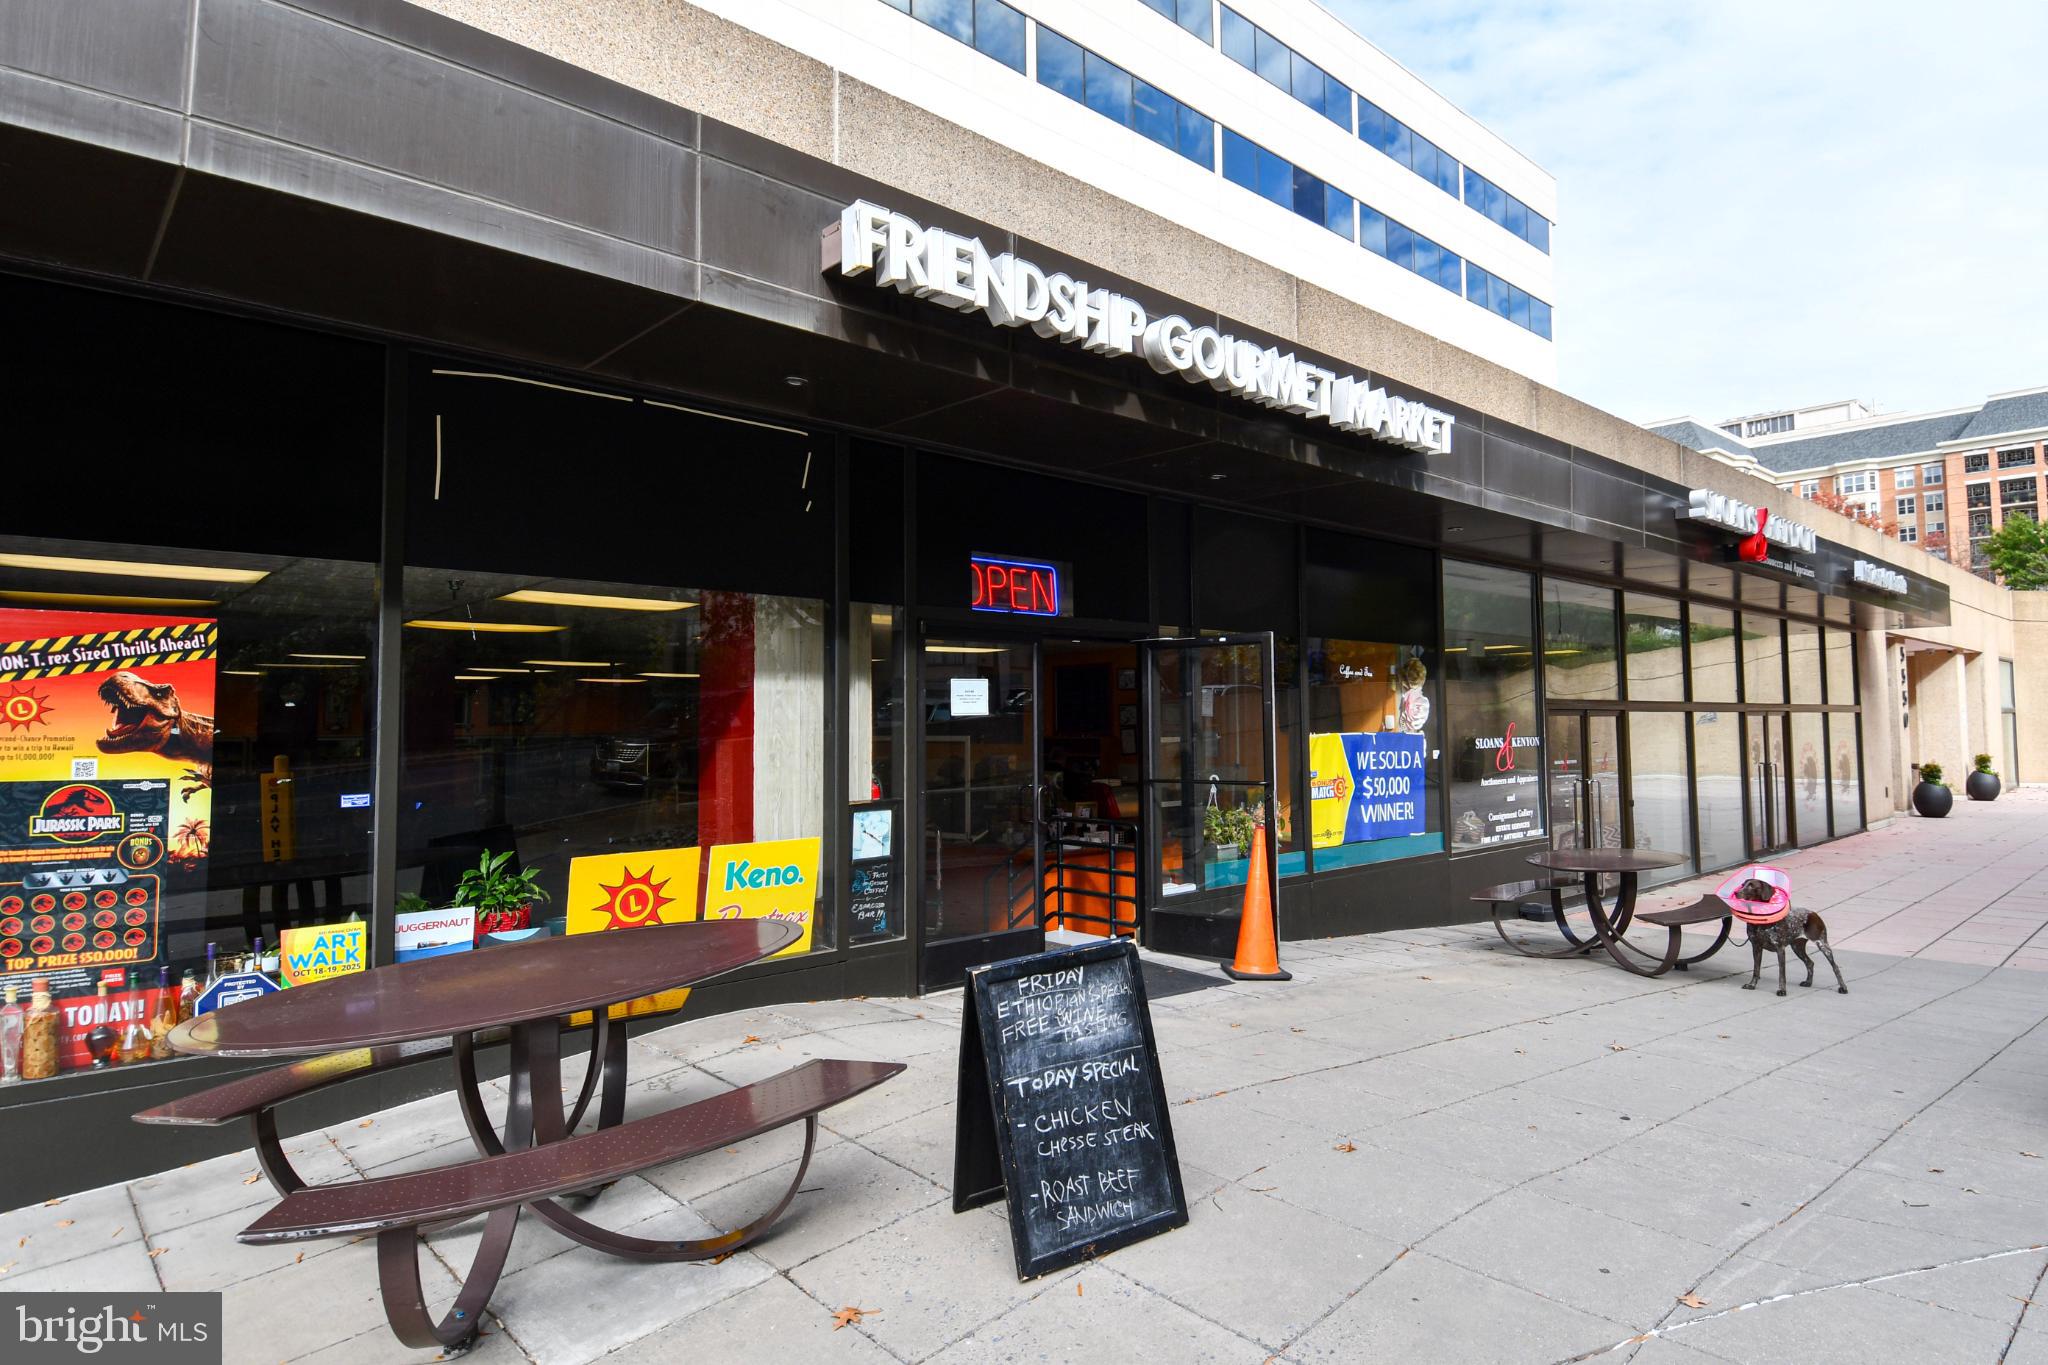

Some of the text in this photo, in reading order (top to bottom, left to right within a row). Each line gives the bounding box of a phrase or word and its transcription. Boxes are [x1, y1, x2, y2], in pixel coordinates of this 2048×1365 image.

[842, 198, 1455, 455] FRIENDSHIP GOURMET MARKET
[31, 652, 45, 668] T.
[48, 653, 71, 665] rex
[73, 646, 110, 663] Sized
[112, 640, 157, 658] Thrills
[159, 634, 206, 653] Ahead!
[1475, 737, 1504, 750] SLOANS
[1511, 736, 1540, 748] KENYON
[1357, 750, 1422, 770] WE SOLD A
[1312, 786, 1335, 799] MATCH
[1362, 775, 1410, 799] $50,000
[1361, 801, 1415, 823] WINNER!
[33, 816, 84, 833] JURASSIC
[87, 815, 121, 832] PARK
[130, 837, 153, 847] BONUS
[725, 859, 804, 891] Keno.
[629, 894, 642, 913] L
[395, 918, 470, 933] JUGGERNAUT
[313, 932, 361, 951] ART
[6, 948, 138, 971] TOP PRIZE $50,000!
[289, 948, 360, 970] WALK
[224, 979, 256, 987] PROTECTED
[293, 970, 311, 978] OCT
[314, 966, 339, 975] 18-19,
[1017, 966, 1084, 996] FRIDAY
[997, 988, 1086, 1019] ETHIOPIAN
[1001, 1004, 1108, 1045] FREE WINE
[1056, 1012, 1128, 1043] TASTING
[1081, 1054, 1140, 1082] SPECIAL
[1034, 1096, 1132, 1133] CHICKEN
[1102, 1121, 1155, 1147] STEAK
[1098, 1168, 1141, 1194] BEEF
[1056, 1198, 1135, 1232] SANDWICH
